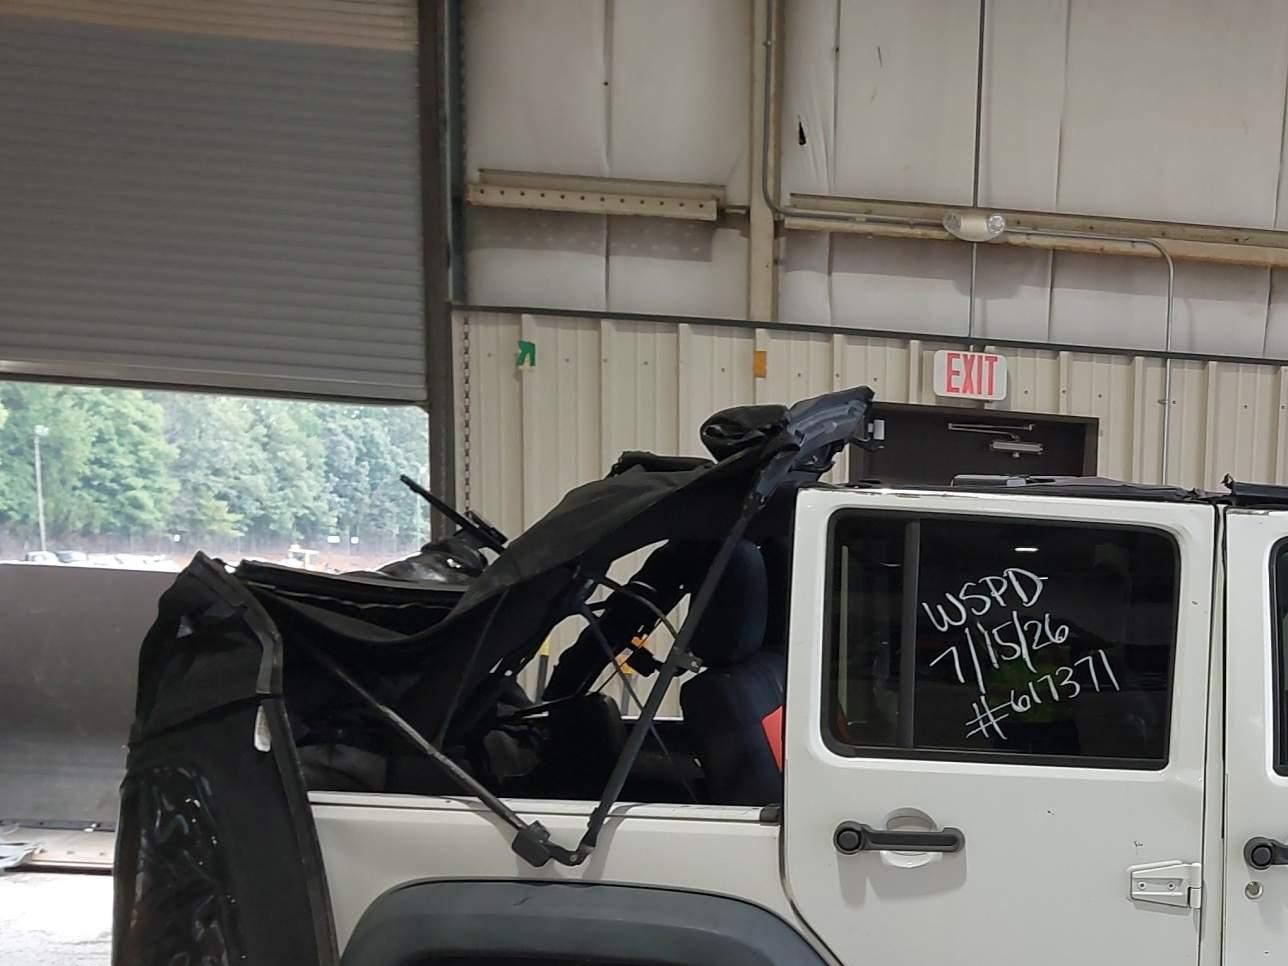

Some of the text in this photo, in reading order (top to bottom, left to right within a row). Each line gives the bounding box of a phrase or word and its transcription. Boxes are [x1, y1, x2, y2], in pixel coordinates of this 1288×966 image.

[946, 352, 998, 396] EXIT
[921, 567, 1049, 632] WSPD
[929, 610, 1069, 694] 7/15/26
